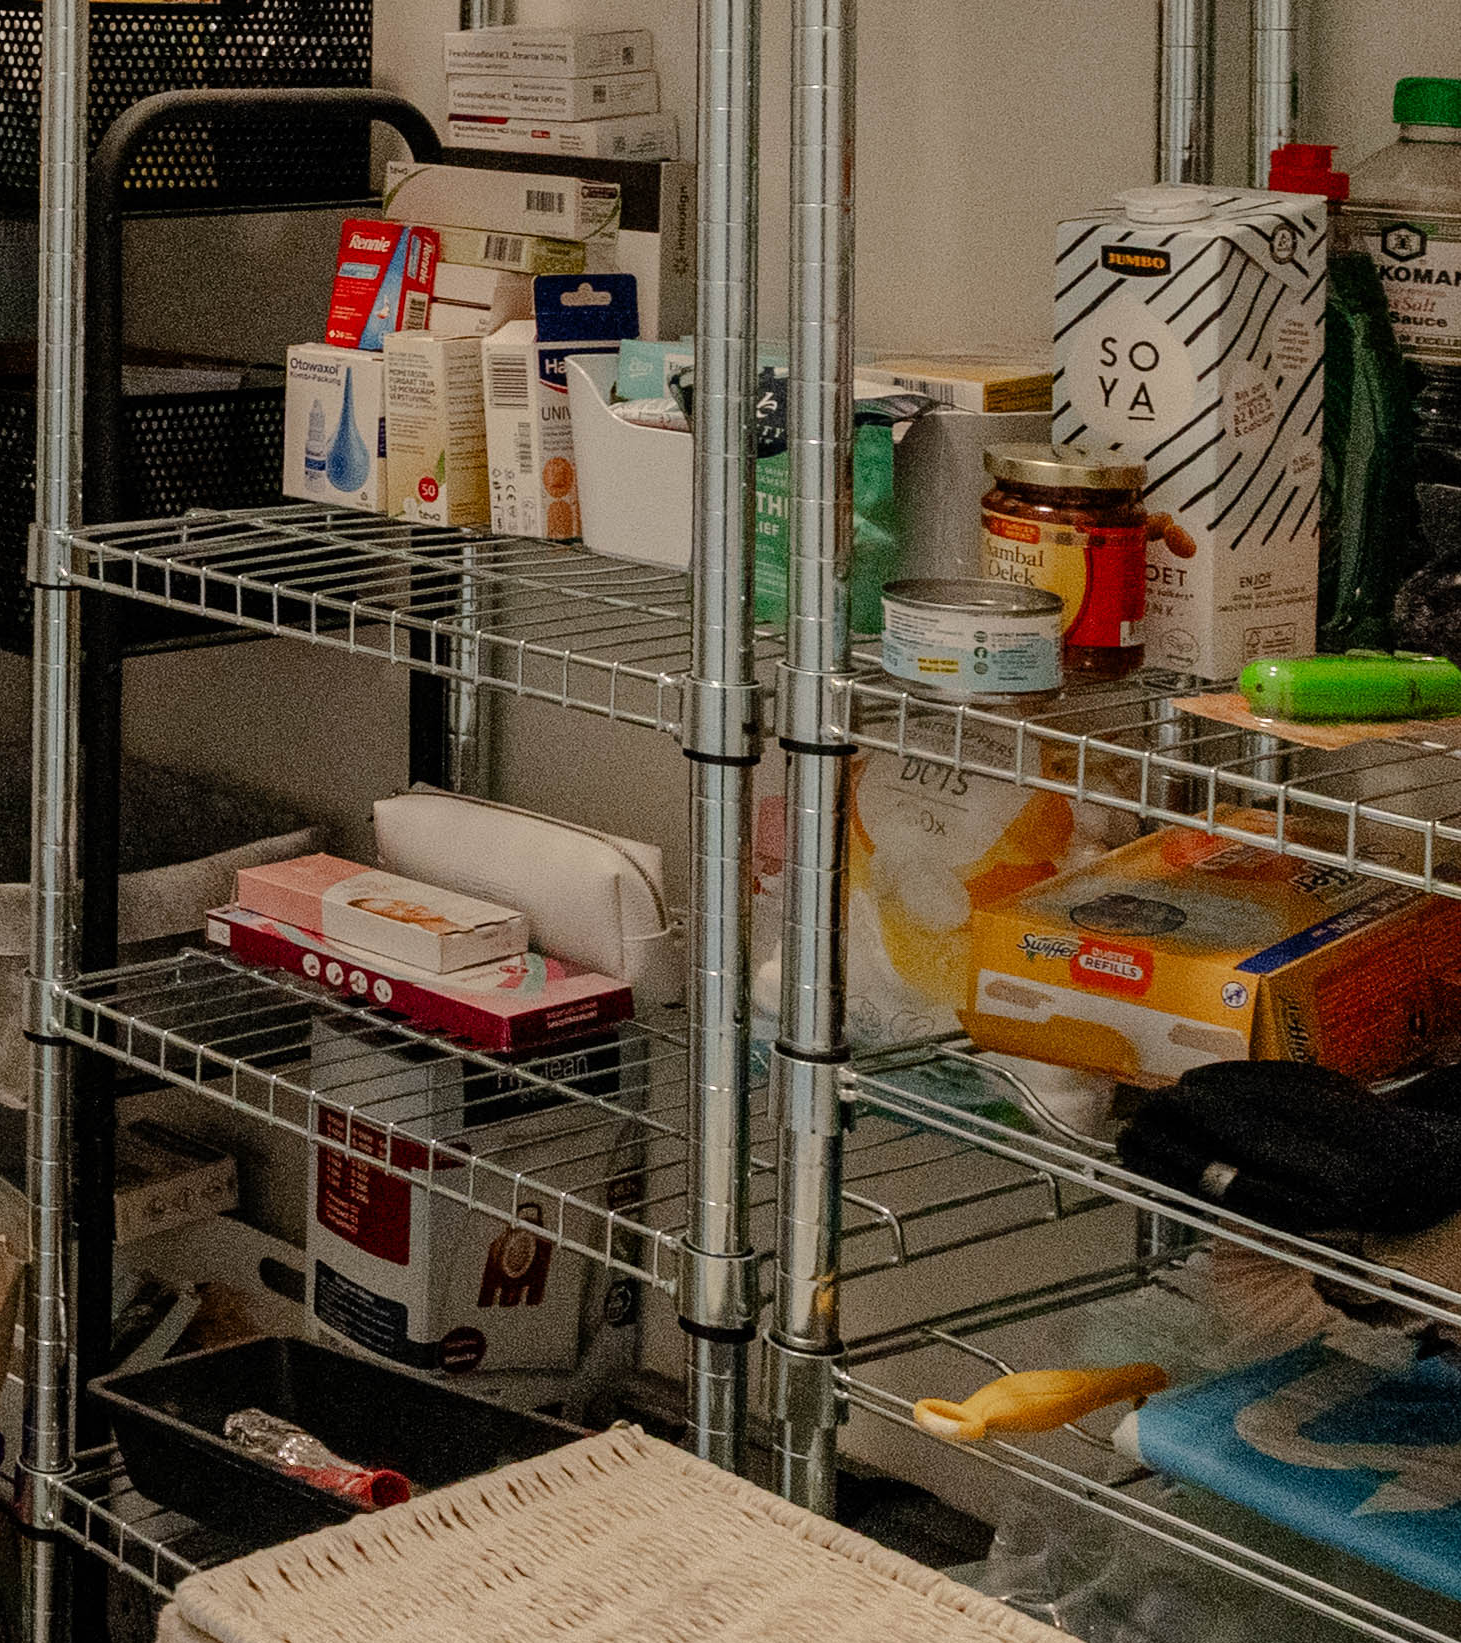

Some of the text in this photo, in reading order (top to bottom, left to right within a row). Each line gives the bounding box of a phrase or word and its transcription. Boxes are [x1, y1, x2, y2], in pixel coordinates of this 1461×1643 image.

[348, 231, 391, 254] Rennie
[419, 237, 435, 285] Rennie
[1108, 252, 1167, 270] JUMBO
[1390, 312, 1447, 328] Sauce
[290, 357, 338, 375] Otowaxol
[421, 483, 436, 497] 50
[419, 509, 441, 522] teva
[985, 539, 1044, 567] Sambal
[987, 560, 1035, 588] Oelek
[1016, 933, 1078, 962] Swiffer
[1084, 957, 1140, 979] REFILLS
